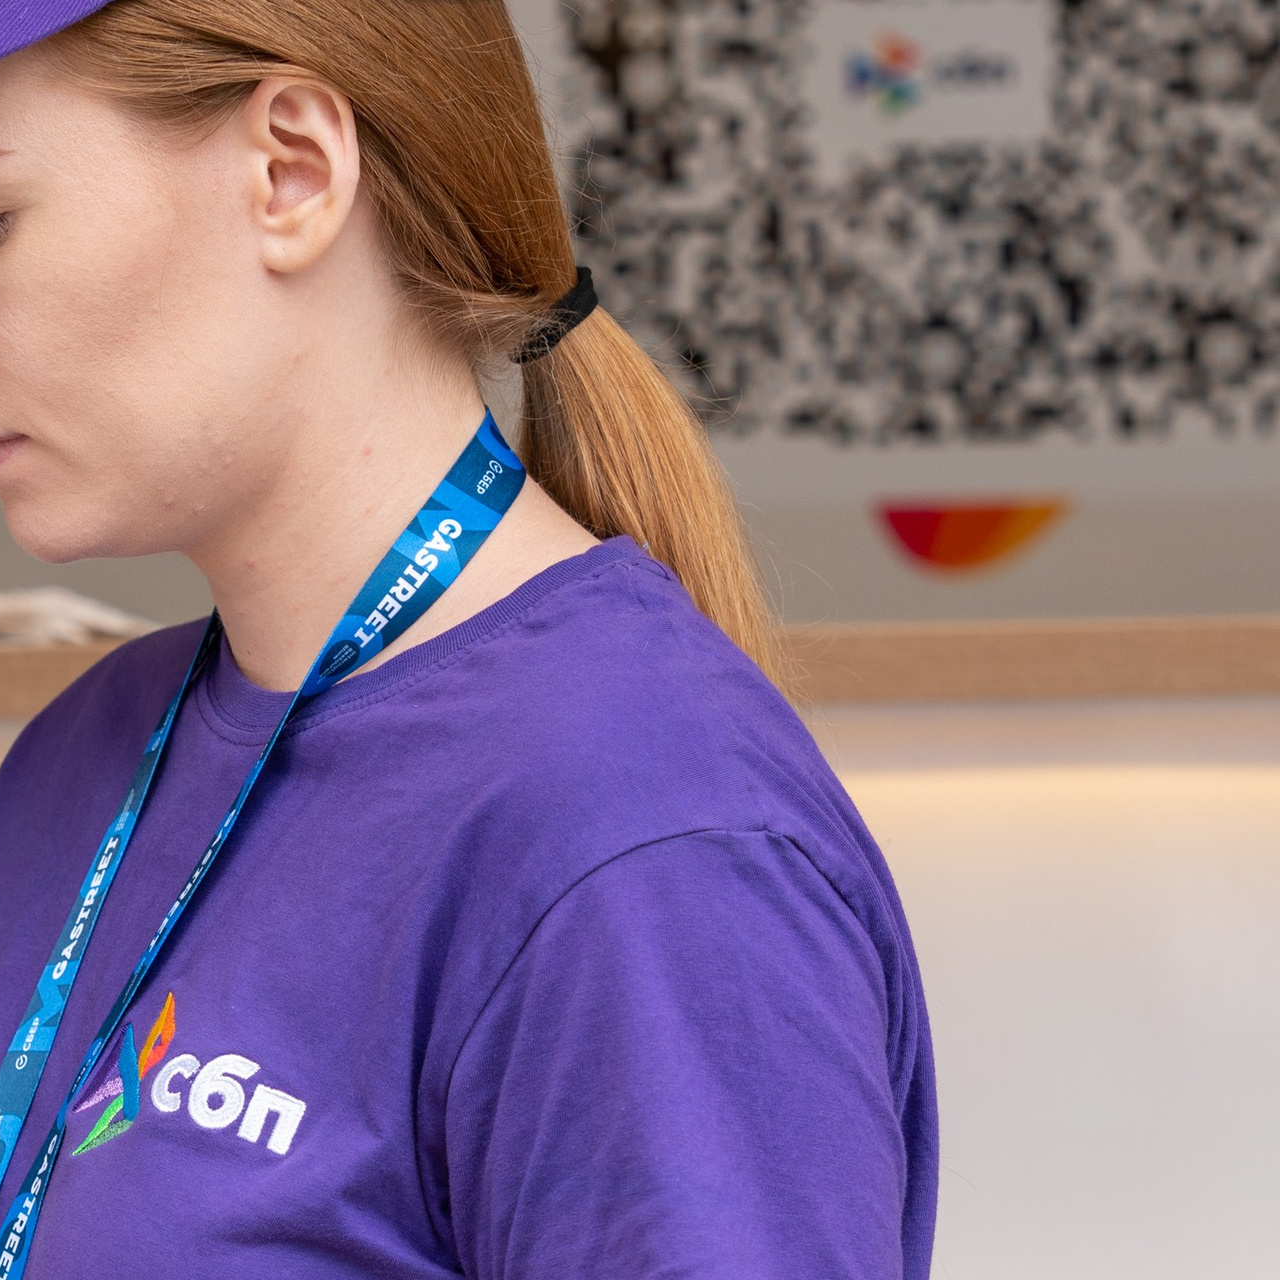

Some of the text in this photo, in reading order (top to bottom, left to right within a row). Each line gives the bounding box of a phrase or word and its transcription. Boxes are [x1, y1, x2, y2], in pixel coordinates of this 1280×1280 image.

[354, 518, 462, 649] GASTREET
[52, 836, 119, 979] GASTREET
[151, 1053, 307, 1155] сбп
